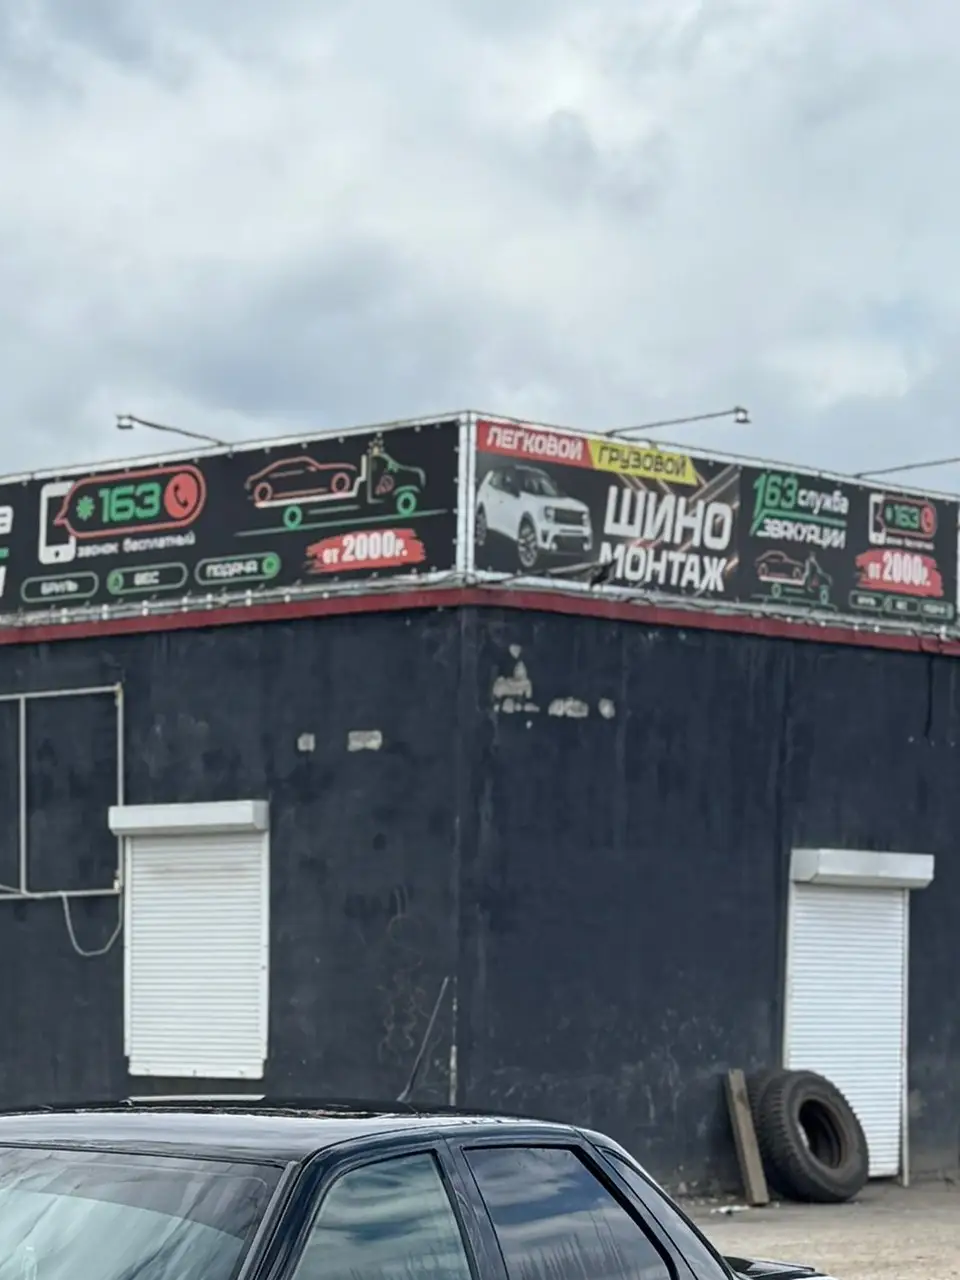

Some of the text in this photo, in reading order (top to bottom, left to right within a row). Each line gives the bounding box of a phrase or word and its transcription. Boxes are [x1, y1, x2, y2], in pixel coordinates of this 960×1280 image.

[487, 427, 584, 460] ЛЕГКОВОЙ
[598, 446, 686, 477] ГРУЗОВОЙ
[98, 483, 162, 523] 163
[753, 474, 849, 518] 163 служба
[604, 486, 733, 550] ШИНО
[600, 542, 728, 592] МОНТАЖ
